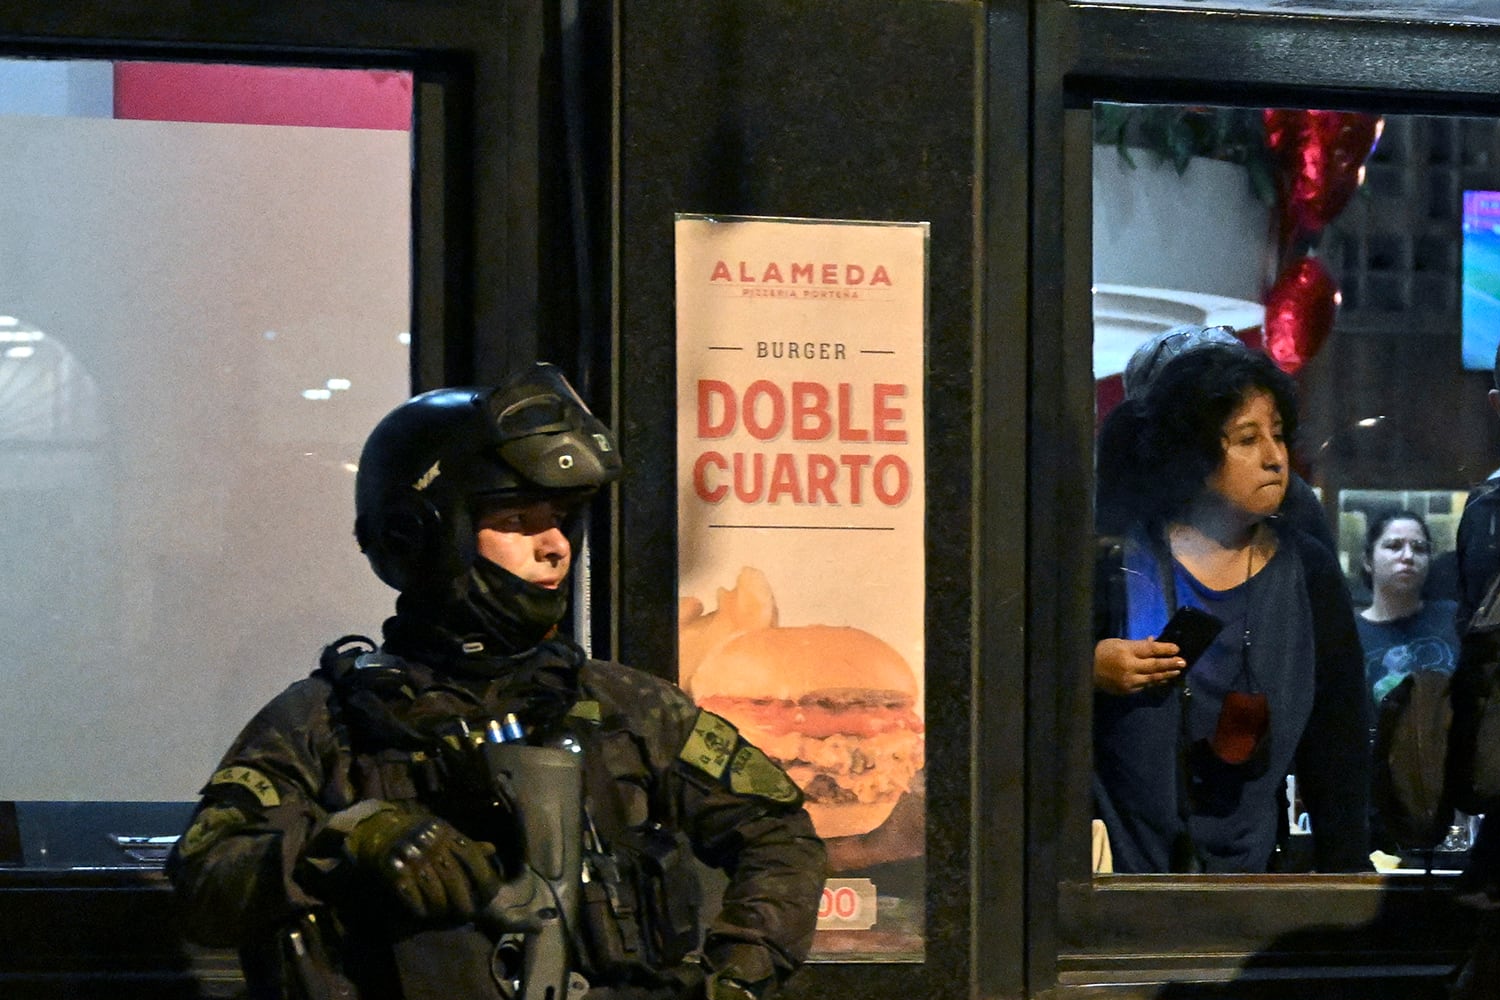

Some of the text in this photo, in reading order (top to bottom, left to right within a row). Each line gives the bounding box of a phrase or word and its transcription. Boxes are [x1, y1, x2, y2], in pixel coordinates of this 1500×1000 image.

[710, 260, 893, 287] ALAMEDA
[742, 288, 797, 298] PIZZERIA
[756, 341, 847, 360] BURGER
[697, 379, 908, 443] DOBLE
[693, 451, 911, 506] CUARTO
